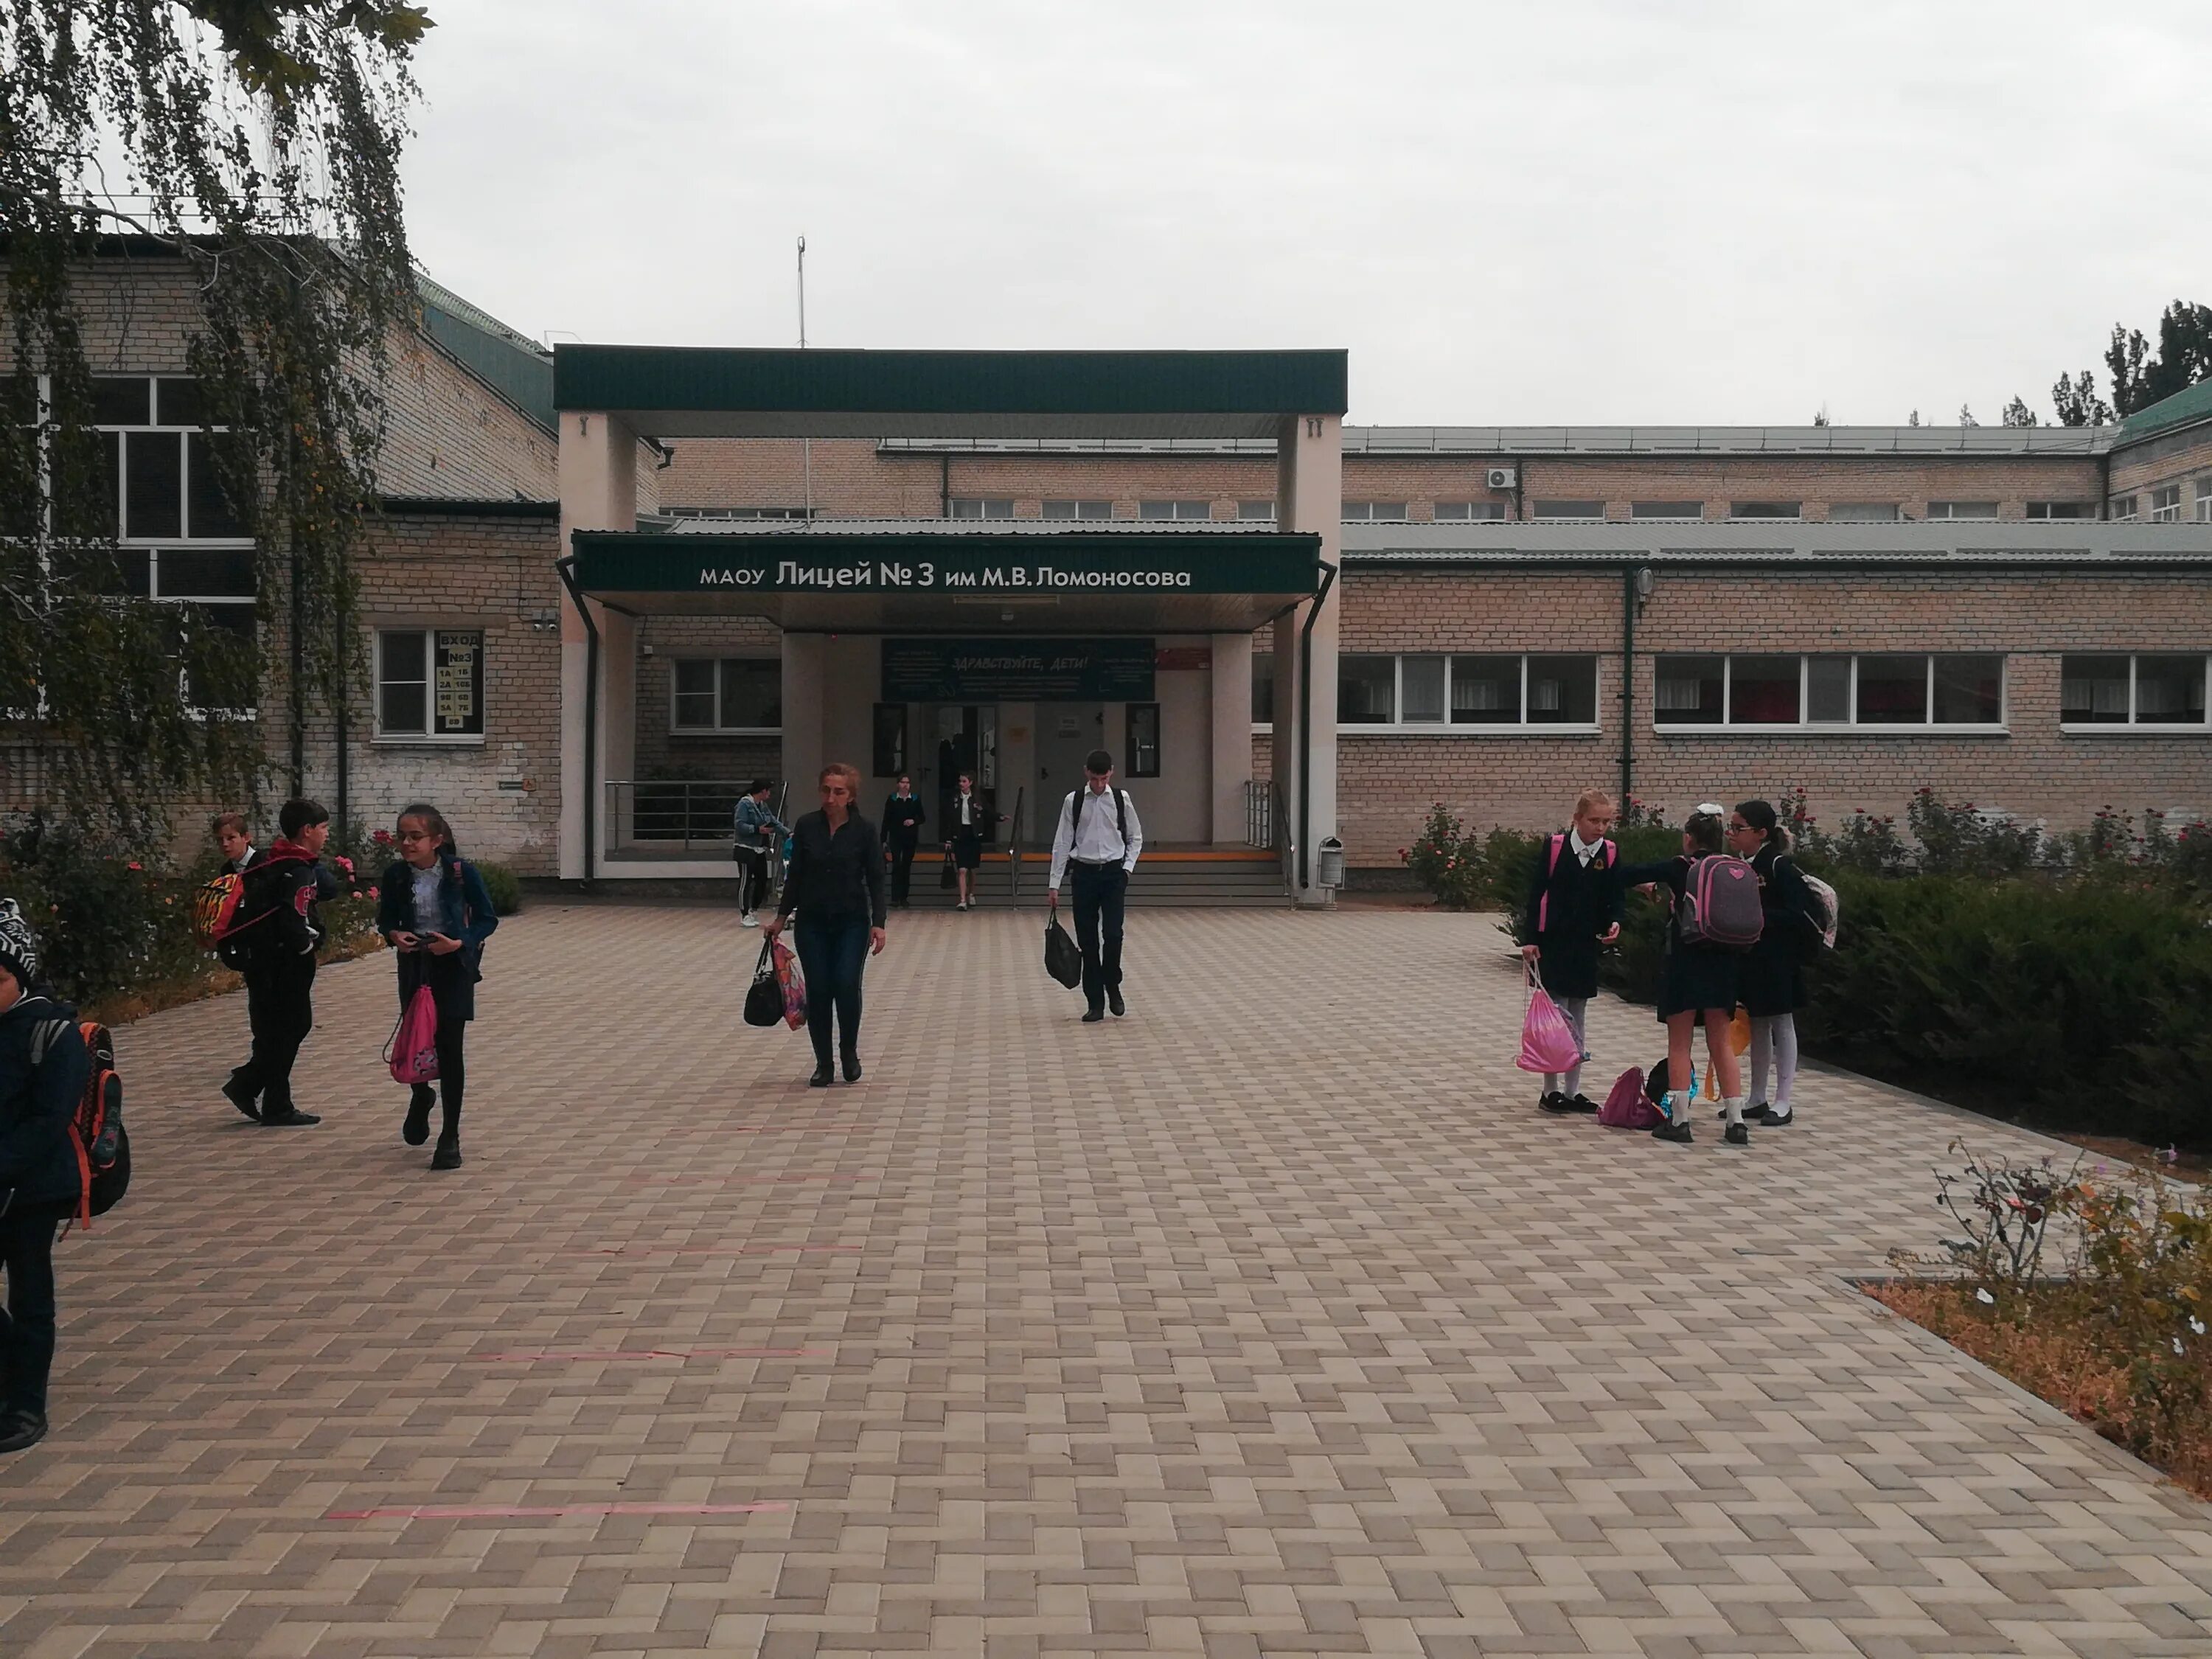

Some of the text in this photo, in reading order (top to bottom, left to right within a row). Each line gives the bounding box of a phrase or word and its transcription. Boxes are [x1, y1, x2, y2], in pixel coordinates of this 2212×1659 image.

[700, 568, 765, 585] МАОУ
[776, 560, 872, 588] Лицей
[945, 571, 976, 585] им
[1036, 567, 1191, 586] Ломоносова
[441, 636, 479, 647] ВХОД
[449, 653, 472, 662] №3
[1049, 655, 1089, 672] ДЕТИ!
